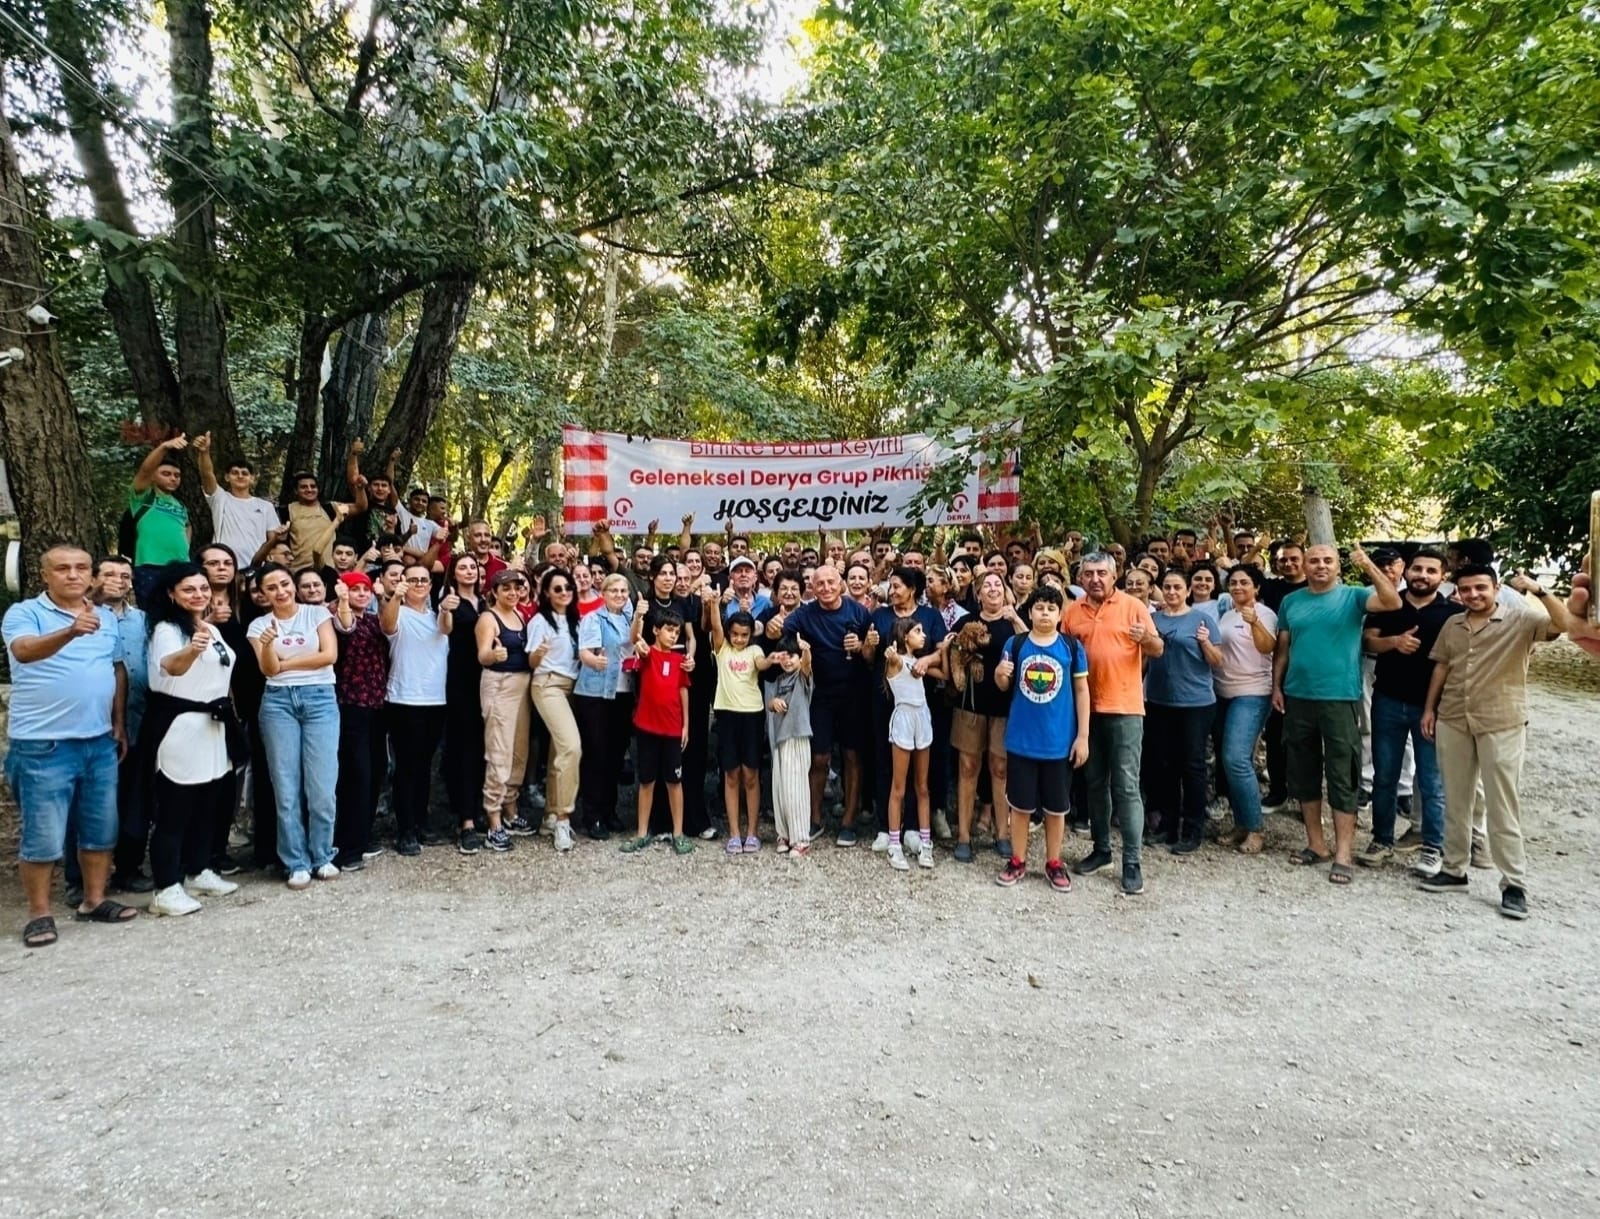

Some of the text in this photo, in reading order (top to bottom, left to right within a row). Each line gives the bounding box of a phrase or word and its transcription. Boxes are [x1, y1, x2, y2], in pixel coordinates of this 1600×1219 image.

[629, 461, 933, 490] Geleneksel Derya Grup Pikniğ
[713, 490, 889, 523] HOŞGELDİNİZ
[609, 519, 637, 527] DERYA
